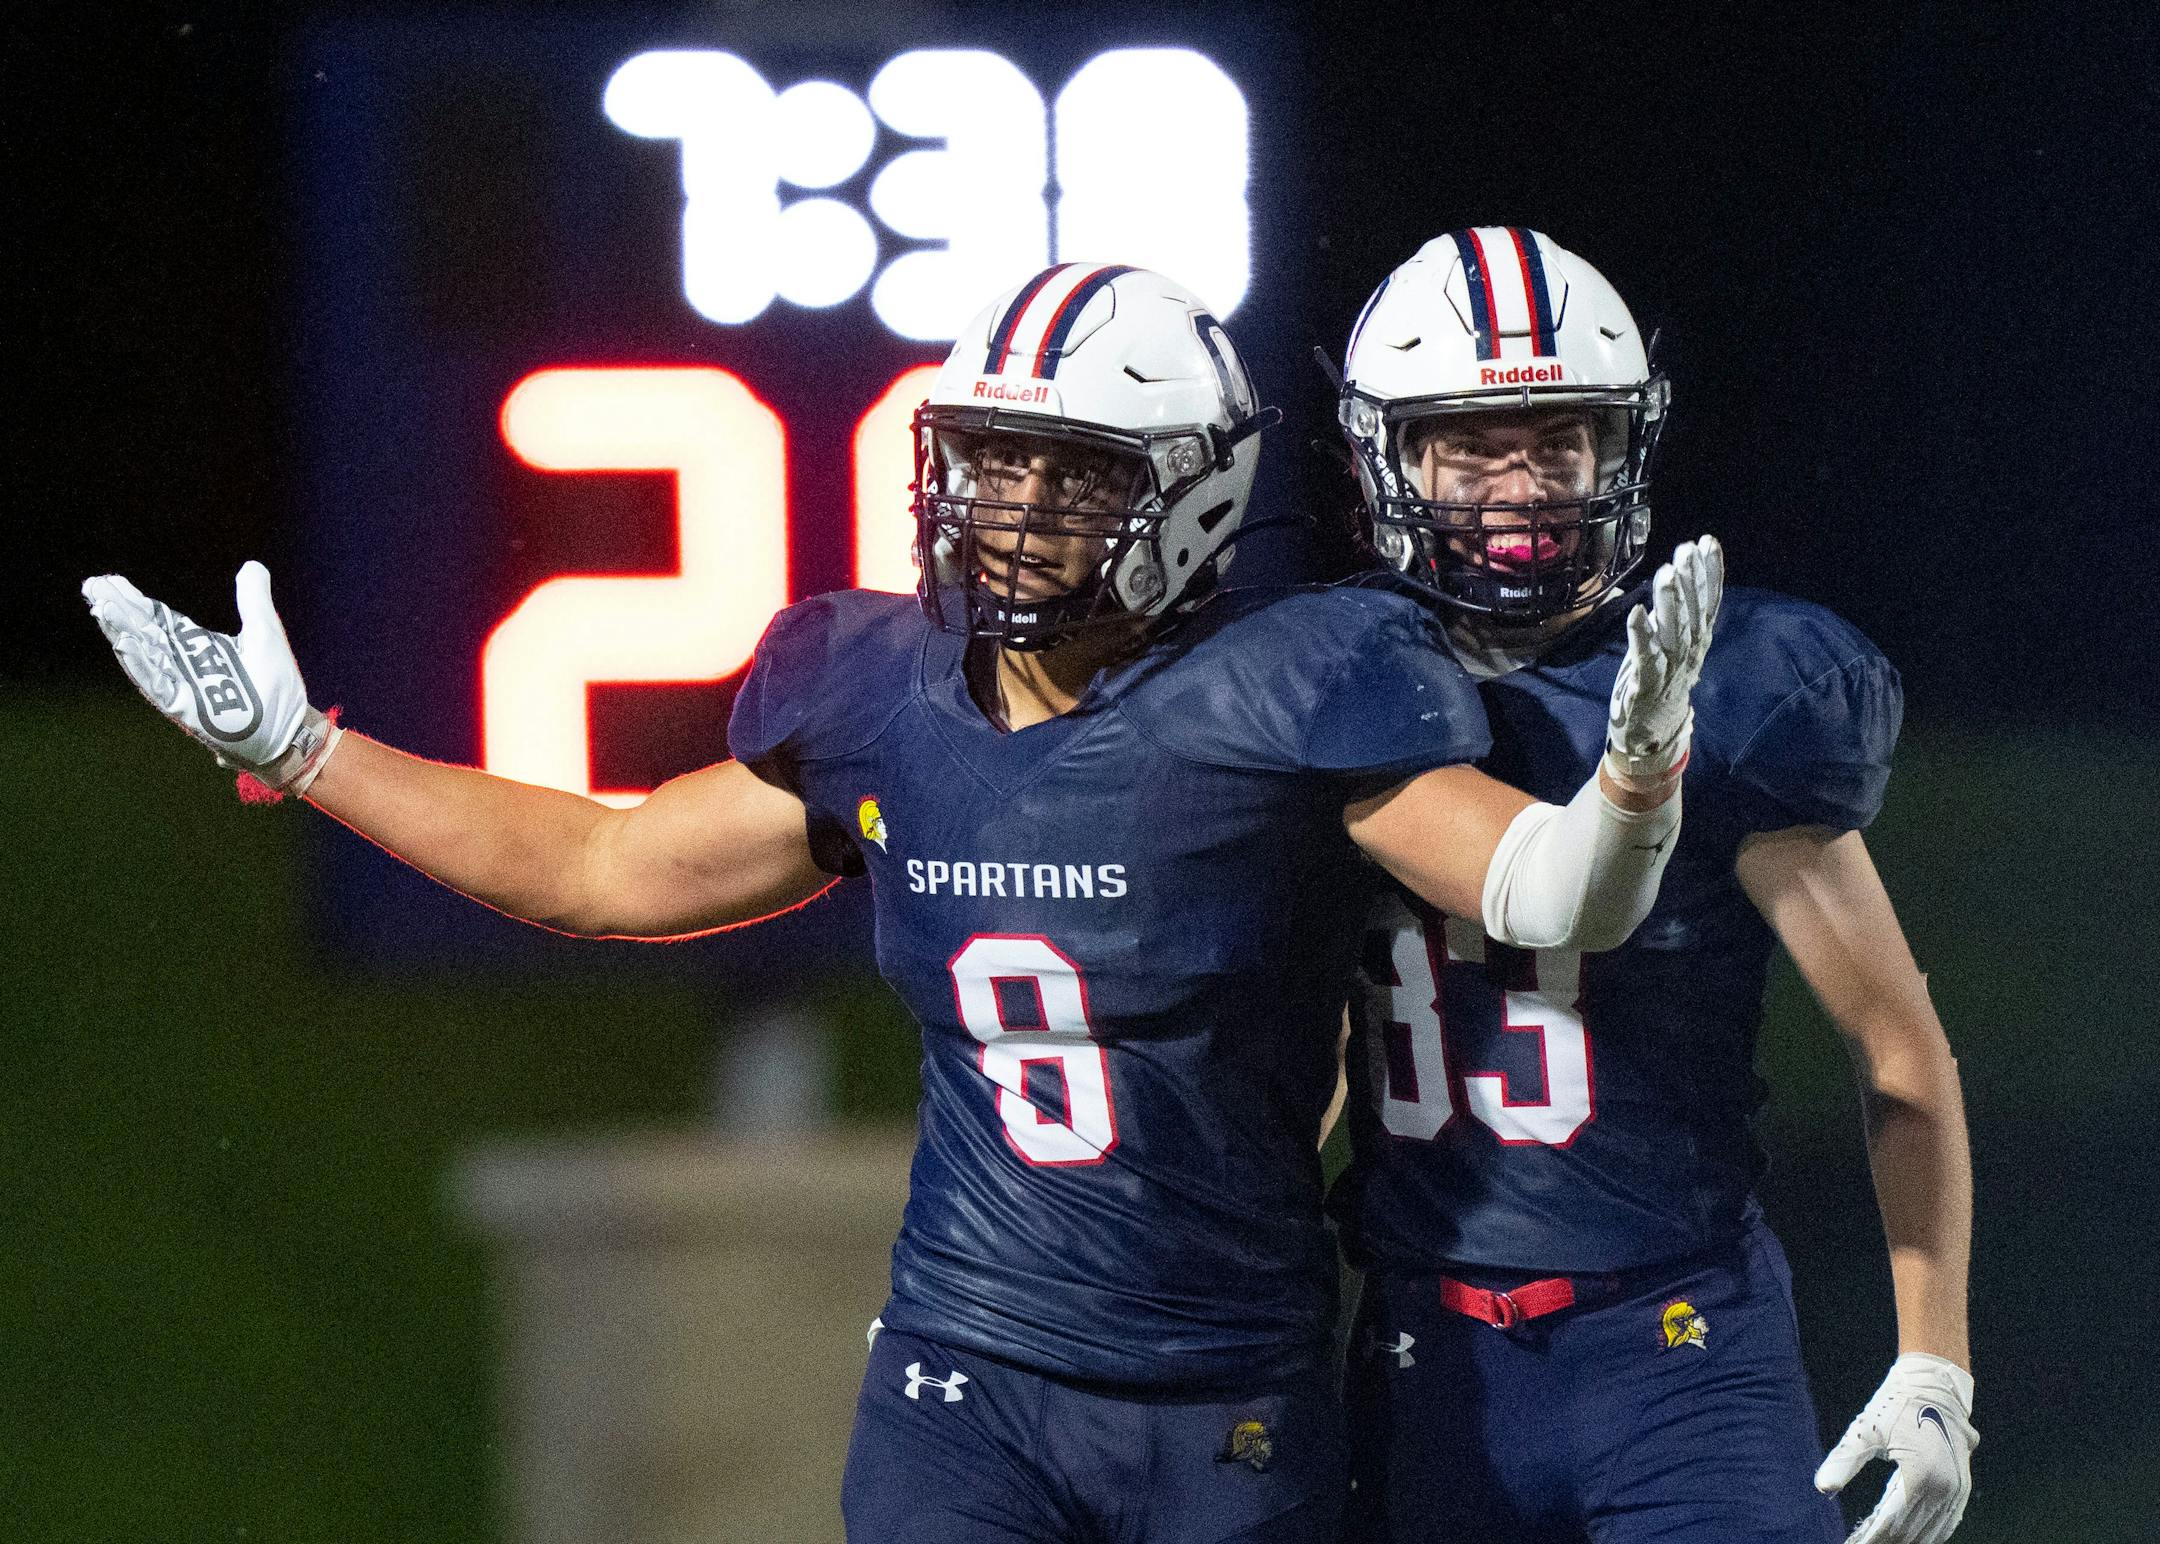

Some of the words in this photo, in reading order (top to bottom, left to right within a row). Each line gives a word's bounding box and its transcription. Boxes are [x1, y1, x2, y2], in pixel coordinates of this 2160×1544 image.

[1480, 364, 1562, 385] Riddell
[973, 381, 1047, 404] Riddell
[1500, 585, 1543, 598] Riddl
[997, 610, 1037, 624] Rdell
[907, 859, 1126, 899] SPARTANS
[946, 932, 1120, 1167] 8
